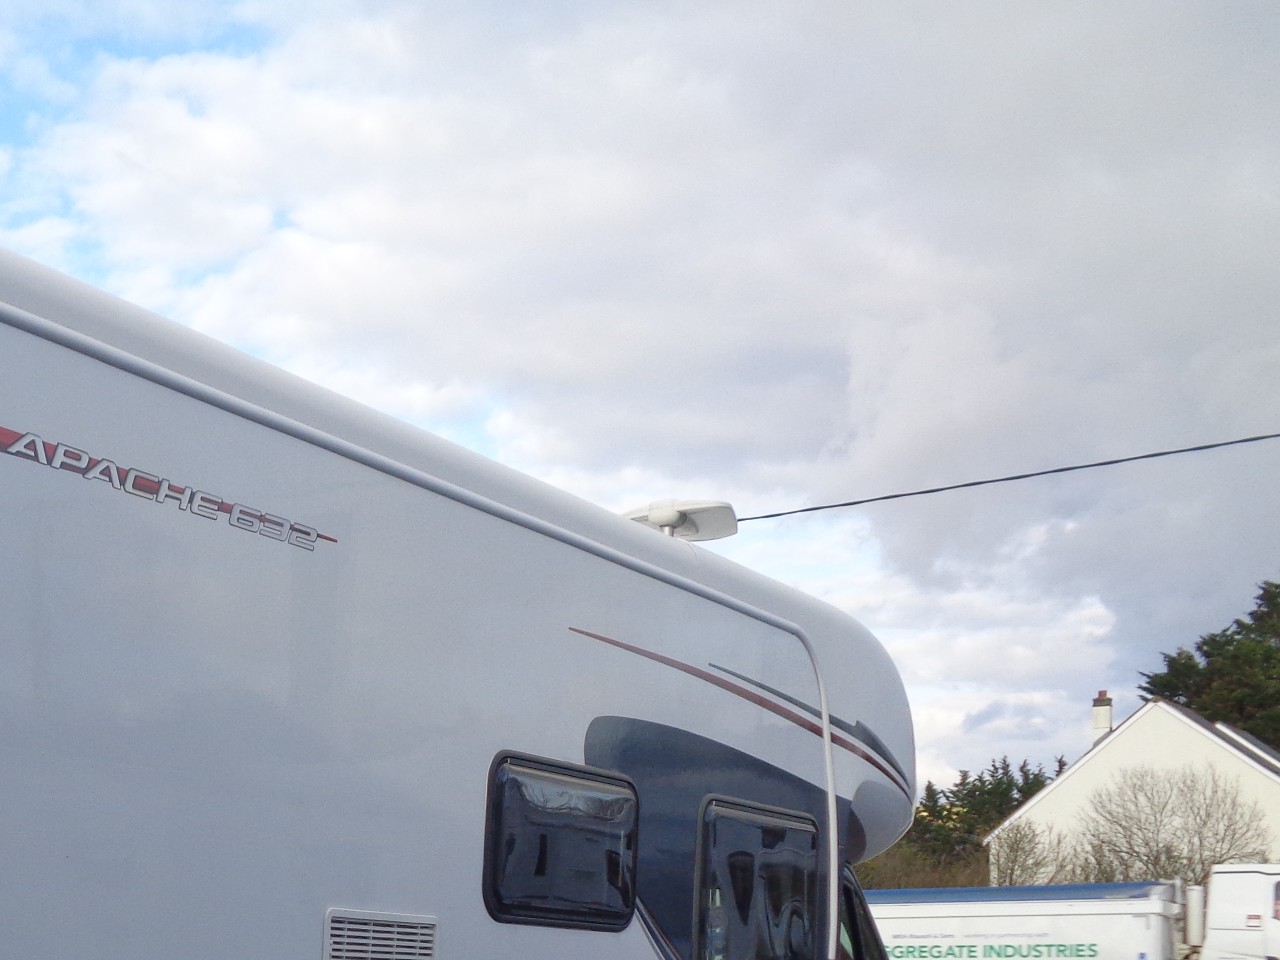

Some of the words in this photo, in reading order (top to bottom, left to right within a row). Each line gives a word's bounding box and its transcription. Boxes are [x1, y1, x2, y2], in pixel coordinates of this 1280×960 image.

[6, 431, 223, 521] APACHE
[228, 502, 319, 552] 632
[982, 942, 1099, 959] INDUSTRIES
